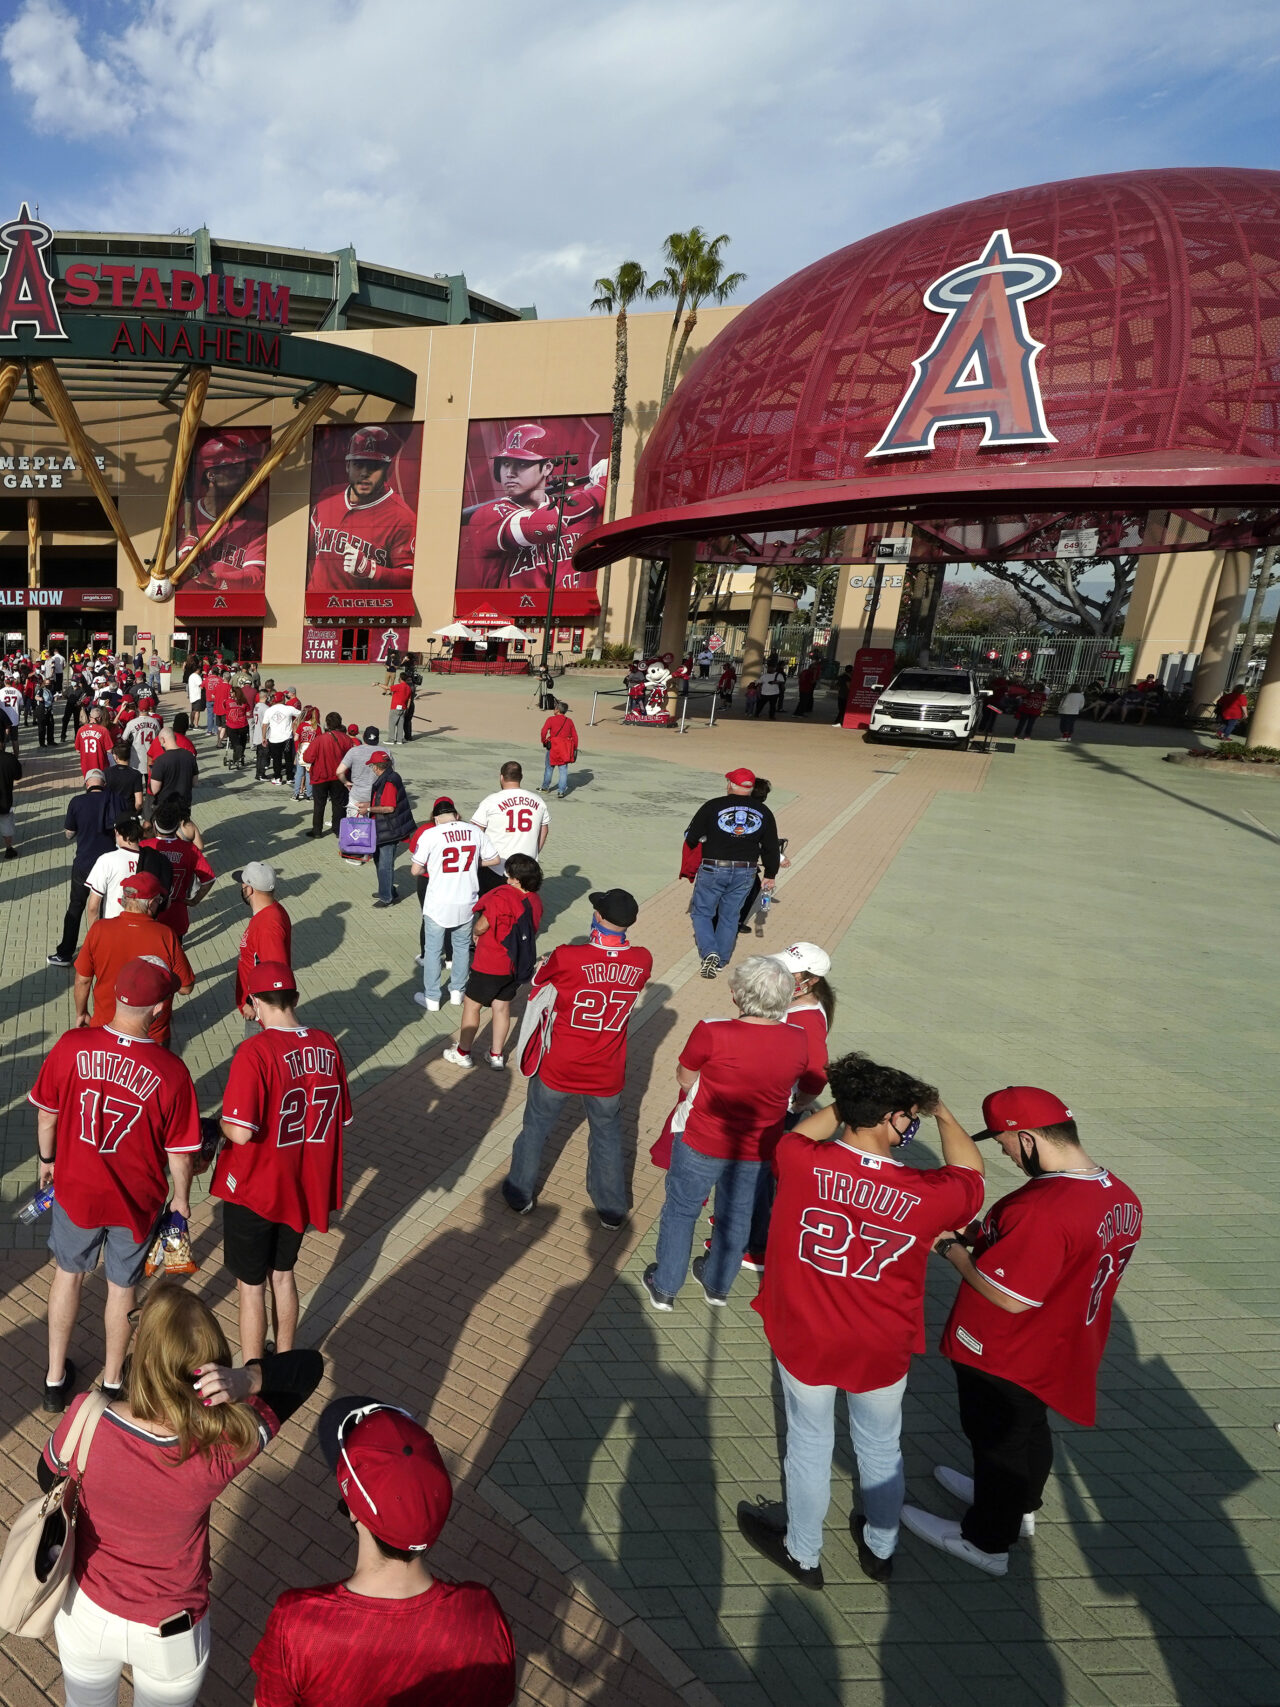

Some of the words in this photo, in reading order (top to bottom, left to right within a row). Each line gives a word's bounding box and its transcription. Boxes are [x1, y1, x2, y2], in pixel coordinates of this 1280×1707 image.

[64, 264, 291, 325] STADIUM
[111, 321, 281, 367] ANAHEIM
[864, 228, 1062, 457] A
[3, 475, 63, 488] GATE
[29, 591, 63, 605] NOW
[327, 595, 393, 607] ANGELS
[307, 629, 336, 639] ANGELS
[308, 640, 333, 649] TEAM
[305, 650, 336, 659] STORE
[4, 696, 18, 707] 27
[84, 739, 97, 753] 13
[497, 797, 540, 812] ANDERSON
[505, 809, 533, 832] 16
[442, 830, 472, 843] TROUT
[442, 845, 476, 873] 27
[582, 963, 643, 985] TROUT
[571, 990, 640, 1031] 27
[283, 1047, 336, 1079] TROUT
[76, 1051, 161, 1101] OHTANI
[79, 1089, 142, 1153] 17
[277, 1084, 340, 1148] 27
[814, 1167, 921, 1223] TROUT
[1097, 1203, 1141, 1249] TROUT
[799, 1207, 916, 1281] 27
